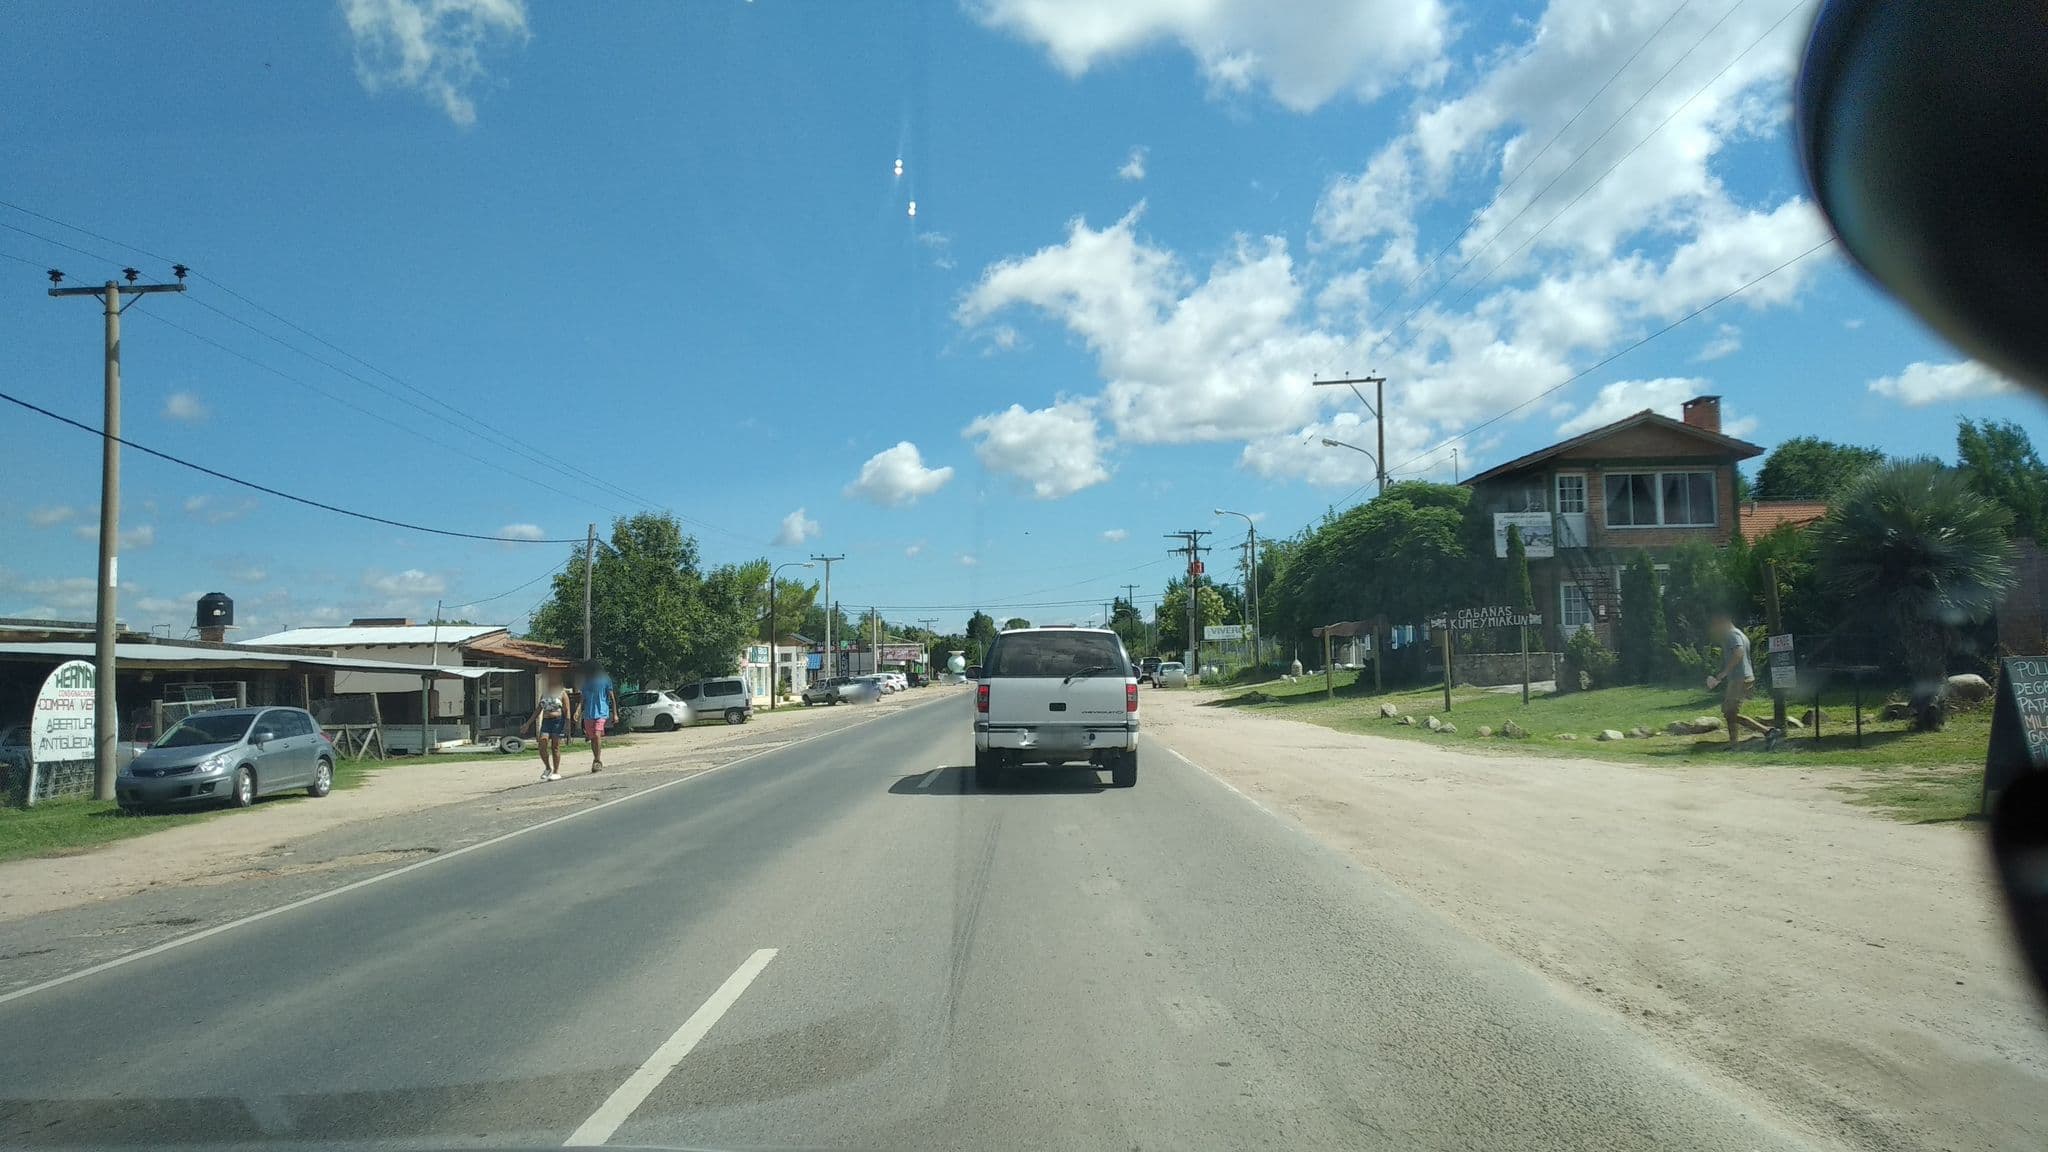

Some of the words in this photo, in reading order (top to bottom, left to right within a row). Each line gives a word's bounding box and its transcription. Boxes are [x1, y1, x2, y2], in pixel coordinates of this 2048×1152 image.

[40, 699, 74, 710] COMPRA
[46, 718, 94, 733] ABERTUR
[2024, 713, 2048, 729] MIL
